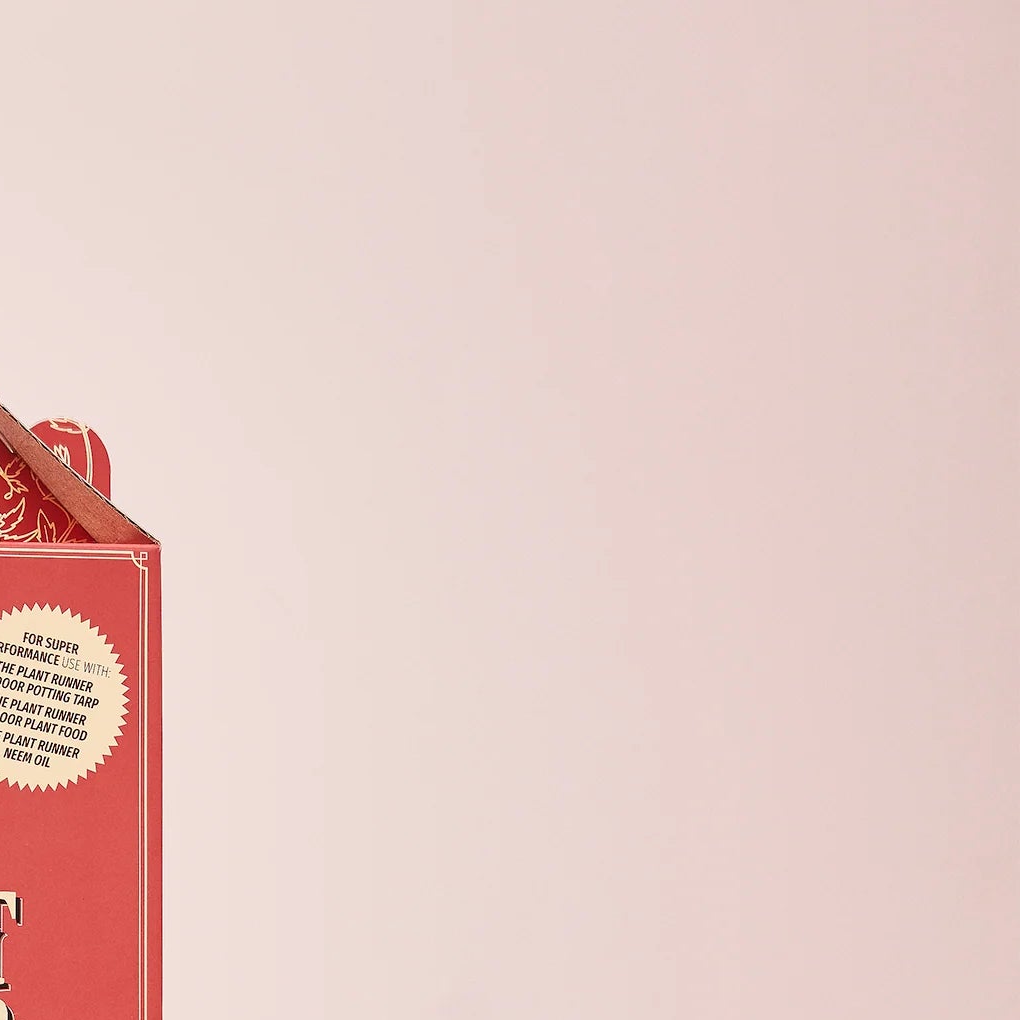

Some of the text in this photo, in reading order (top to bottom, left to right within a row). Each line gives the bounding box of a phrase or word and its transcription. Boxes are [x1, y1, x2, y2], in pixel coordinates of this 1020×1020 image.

[23, 632, 79, 655] FOR SUPER
[16, 665, 51, 683] PLANT
[51, 674, 93, 693] RUNNER
[61, 656, 81, 671] USE
[83, 662, 112, 678] WITH:
[26, 683, 71, 703] POTTING
[73, 694, 100, 709] TARP
[10, 699, 44, 716] PLANT
[44, 707, 87, 726] RUNNER
[24, 718, 58, 735] PLANT
[58, 726, 88, 741] FOOD
[3, 732, 37, 750] PLANT
[38, 740, 80, 759] RUNNER
[3, 748, 51, 768] NEEM OIL
